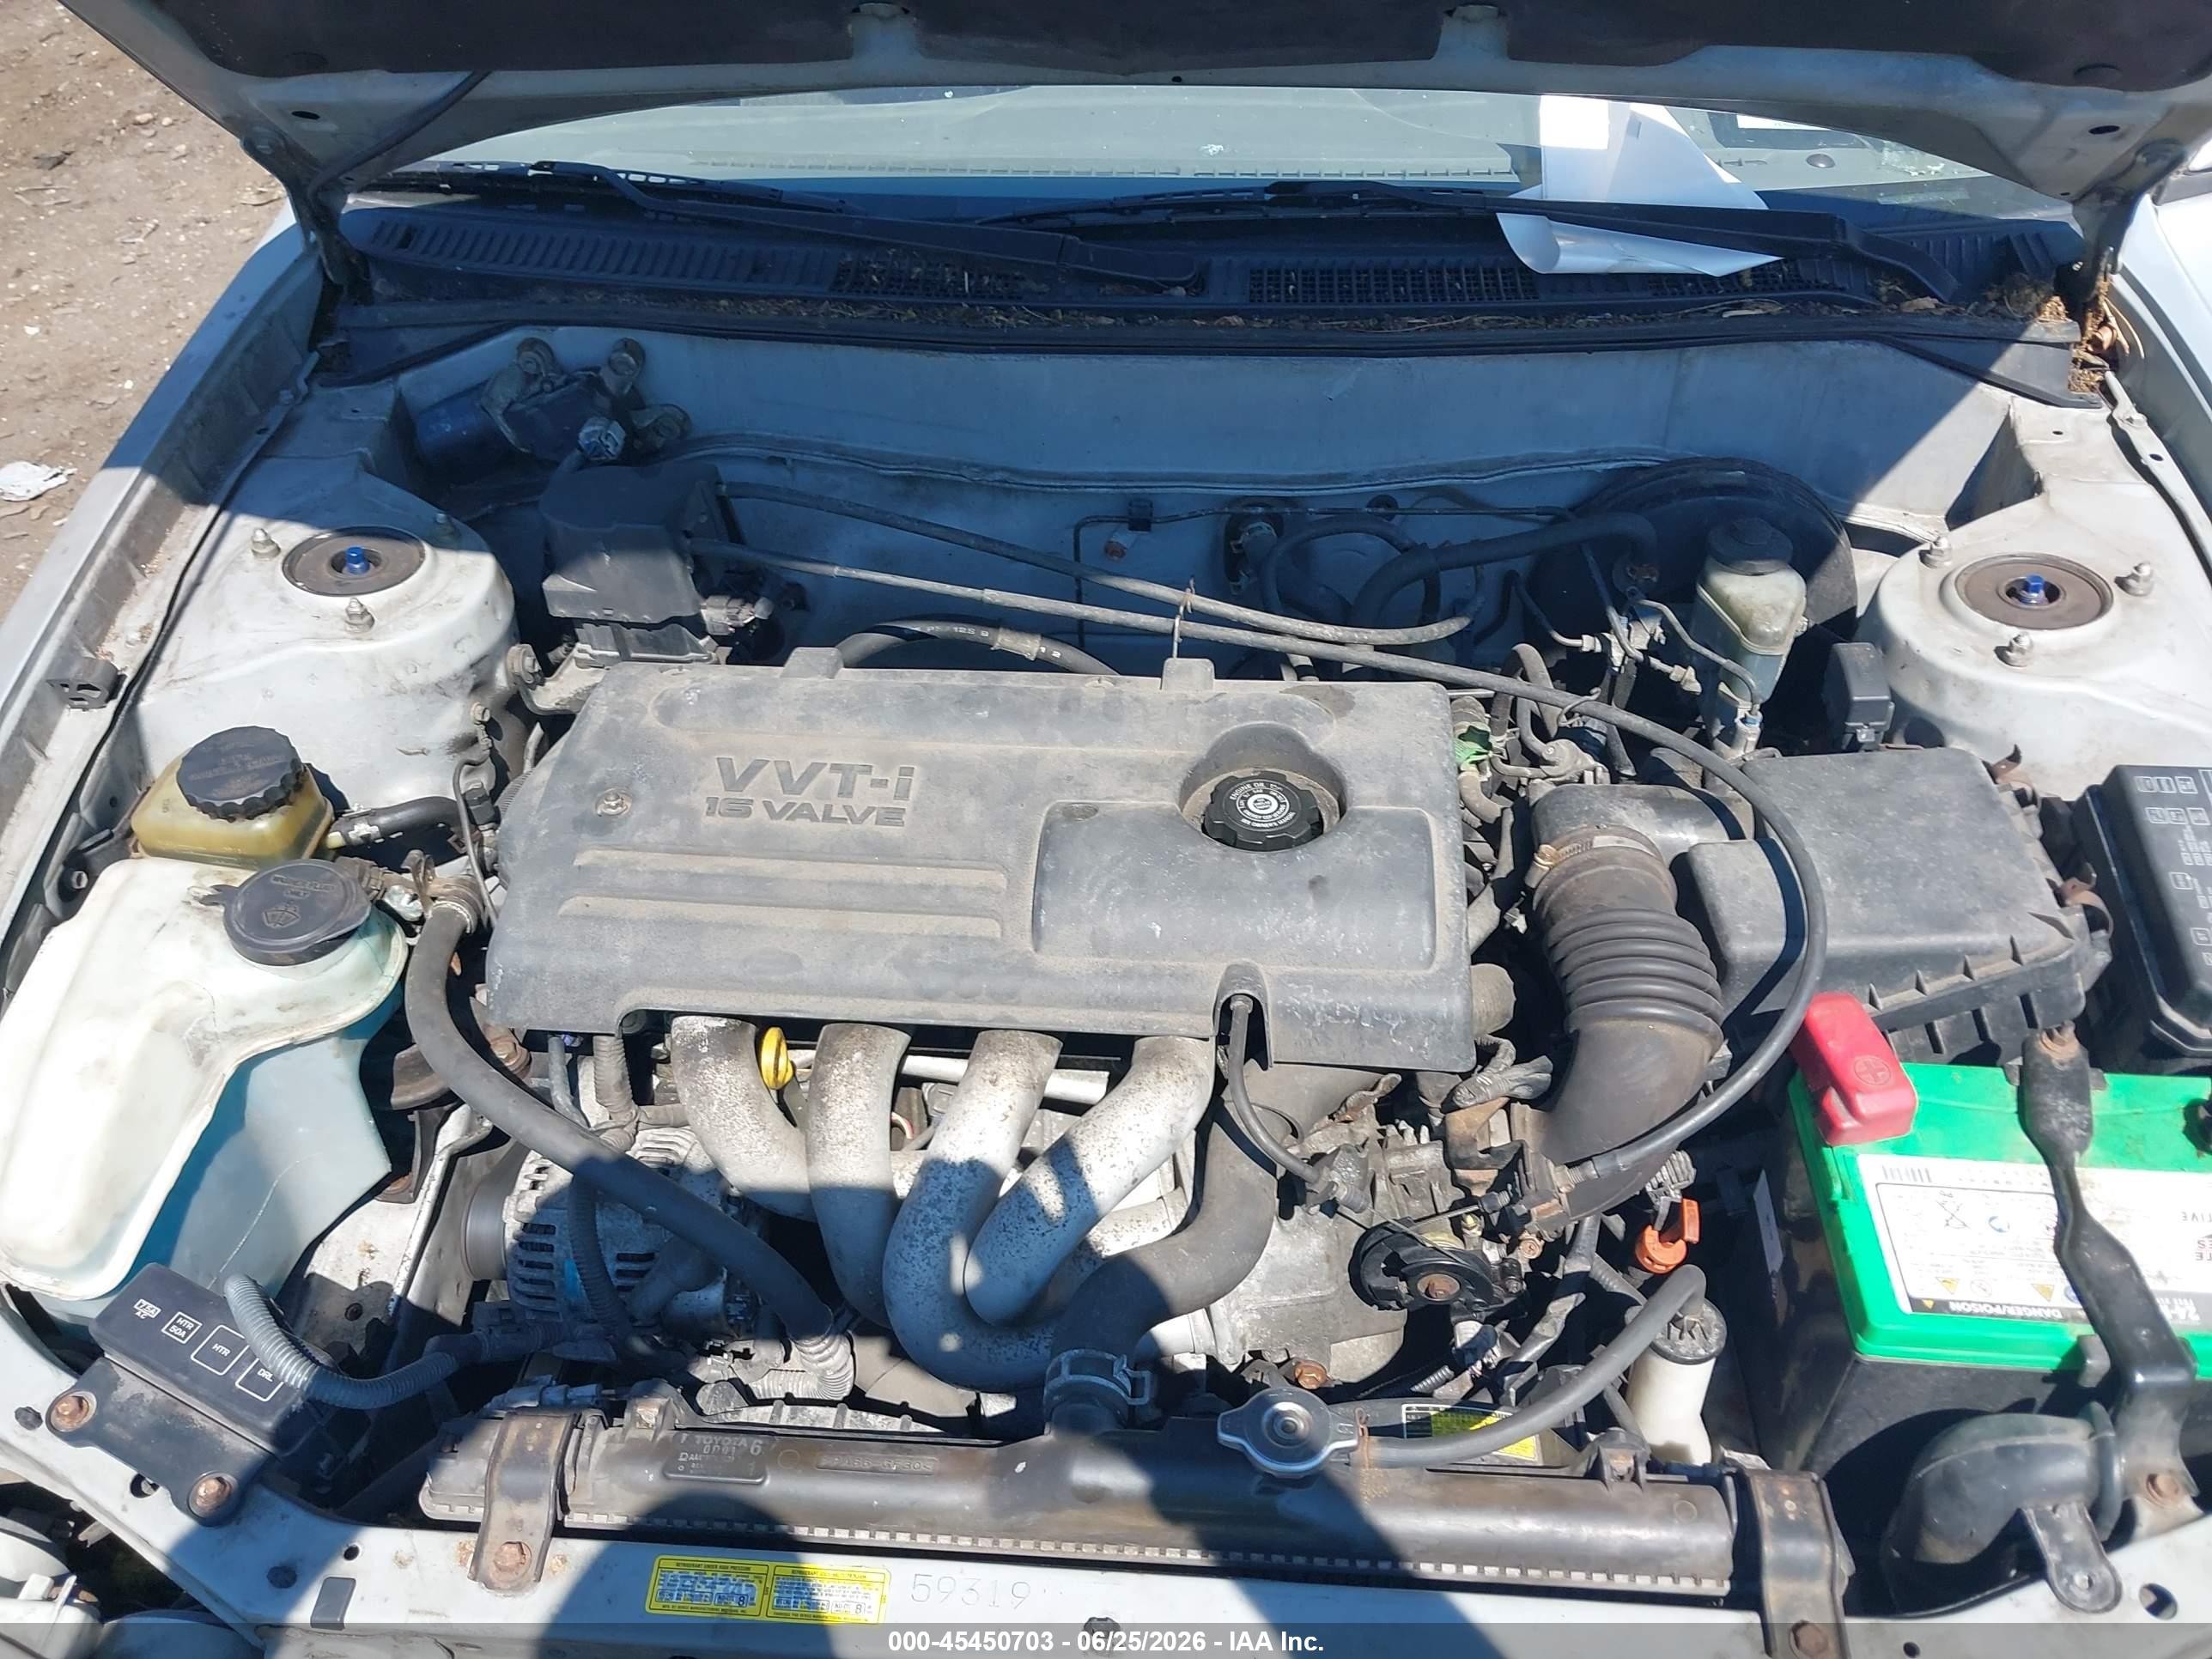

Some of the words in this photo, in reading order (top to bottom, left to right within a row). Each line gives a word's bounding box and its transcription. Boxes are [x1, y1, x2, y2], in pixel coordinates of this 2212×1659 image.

[716, 757, 915, 801] VVT-i
[1229, 783, 1251, 800] ENGINE
[706, 796, 754, 818] 16
[762, 799, 907, 827] VALVE
[1950, 1301, 2063, 1319] DANGER/POISON
[176, 1317, 195, 1330] HTR
[168, 1325, 186, 1338] 50A
[211, 1343, 231, 1357] HTR
[257, 1368, 274, 1382] DRL
[695, 1435, 748, 1448] TOYOTA
[750, 1439, 763, 1456] 6
[910, 1572, 1030, 1610] 59319
[738, 1595, 745, 1607] 8
[855, 1604, 863, 1615] 8
